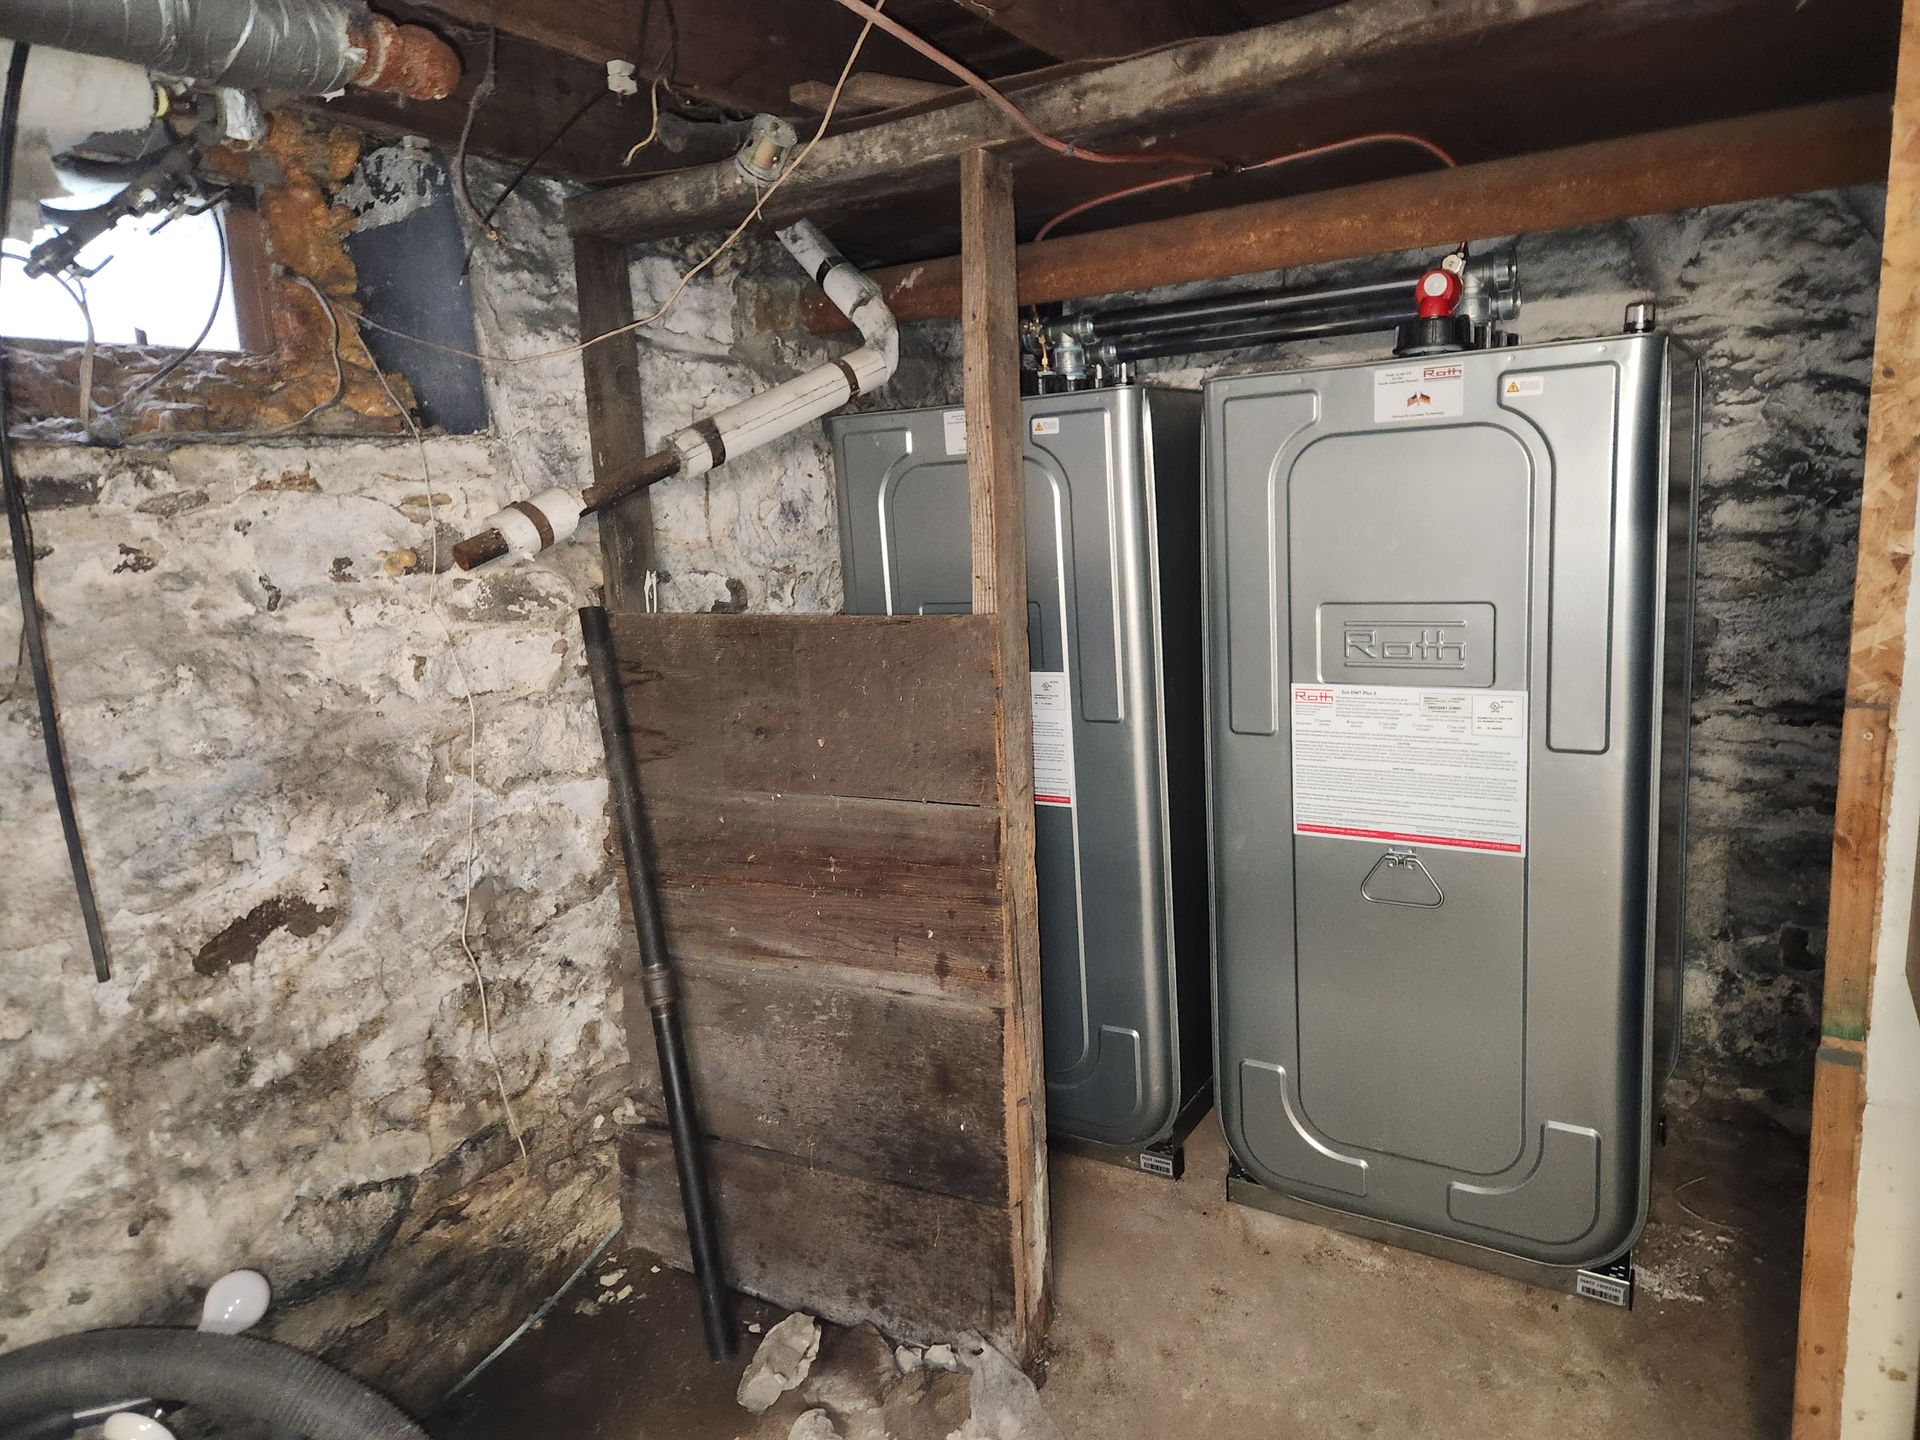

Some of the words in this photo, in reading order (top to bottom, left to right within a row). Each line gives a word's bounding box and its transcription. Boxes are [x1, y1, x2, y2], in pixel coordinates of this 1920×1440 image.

[1424, 367, 1461, 377] Roth
[1344, 630, 1466, 659] Roth
[1295, 691, 1334, 702] Roth
